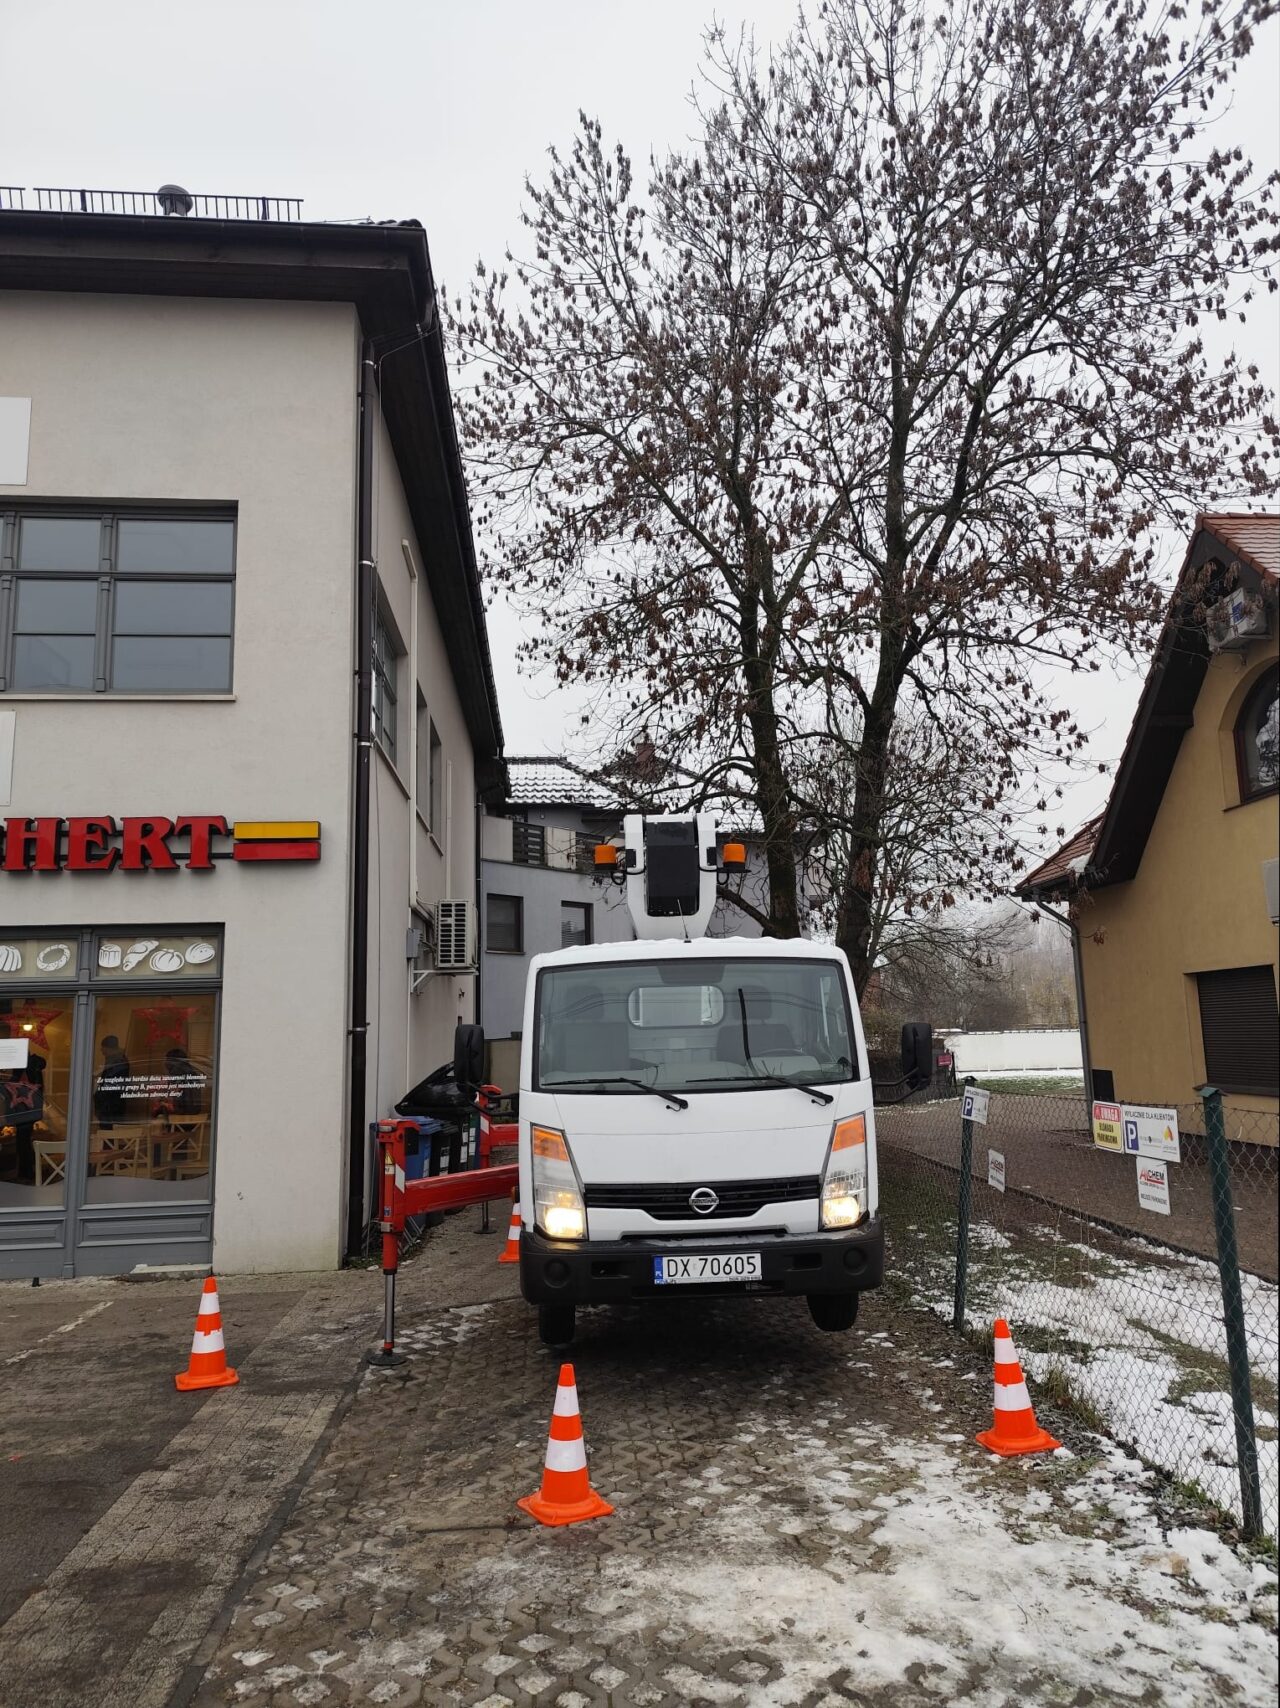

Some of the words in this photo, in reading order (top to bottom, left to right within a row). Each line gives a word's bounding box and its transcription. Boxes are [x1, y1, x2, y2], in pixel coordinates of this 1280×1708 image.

[0, 816, 228, 871] HERT
[1101, 1107, 1119, 1122] UWAGA
[667, 1258, 690, 1278] DX
[698, 1255, 757, 1277] 70605
